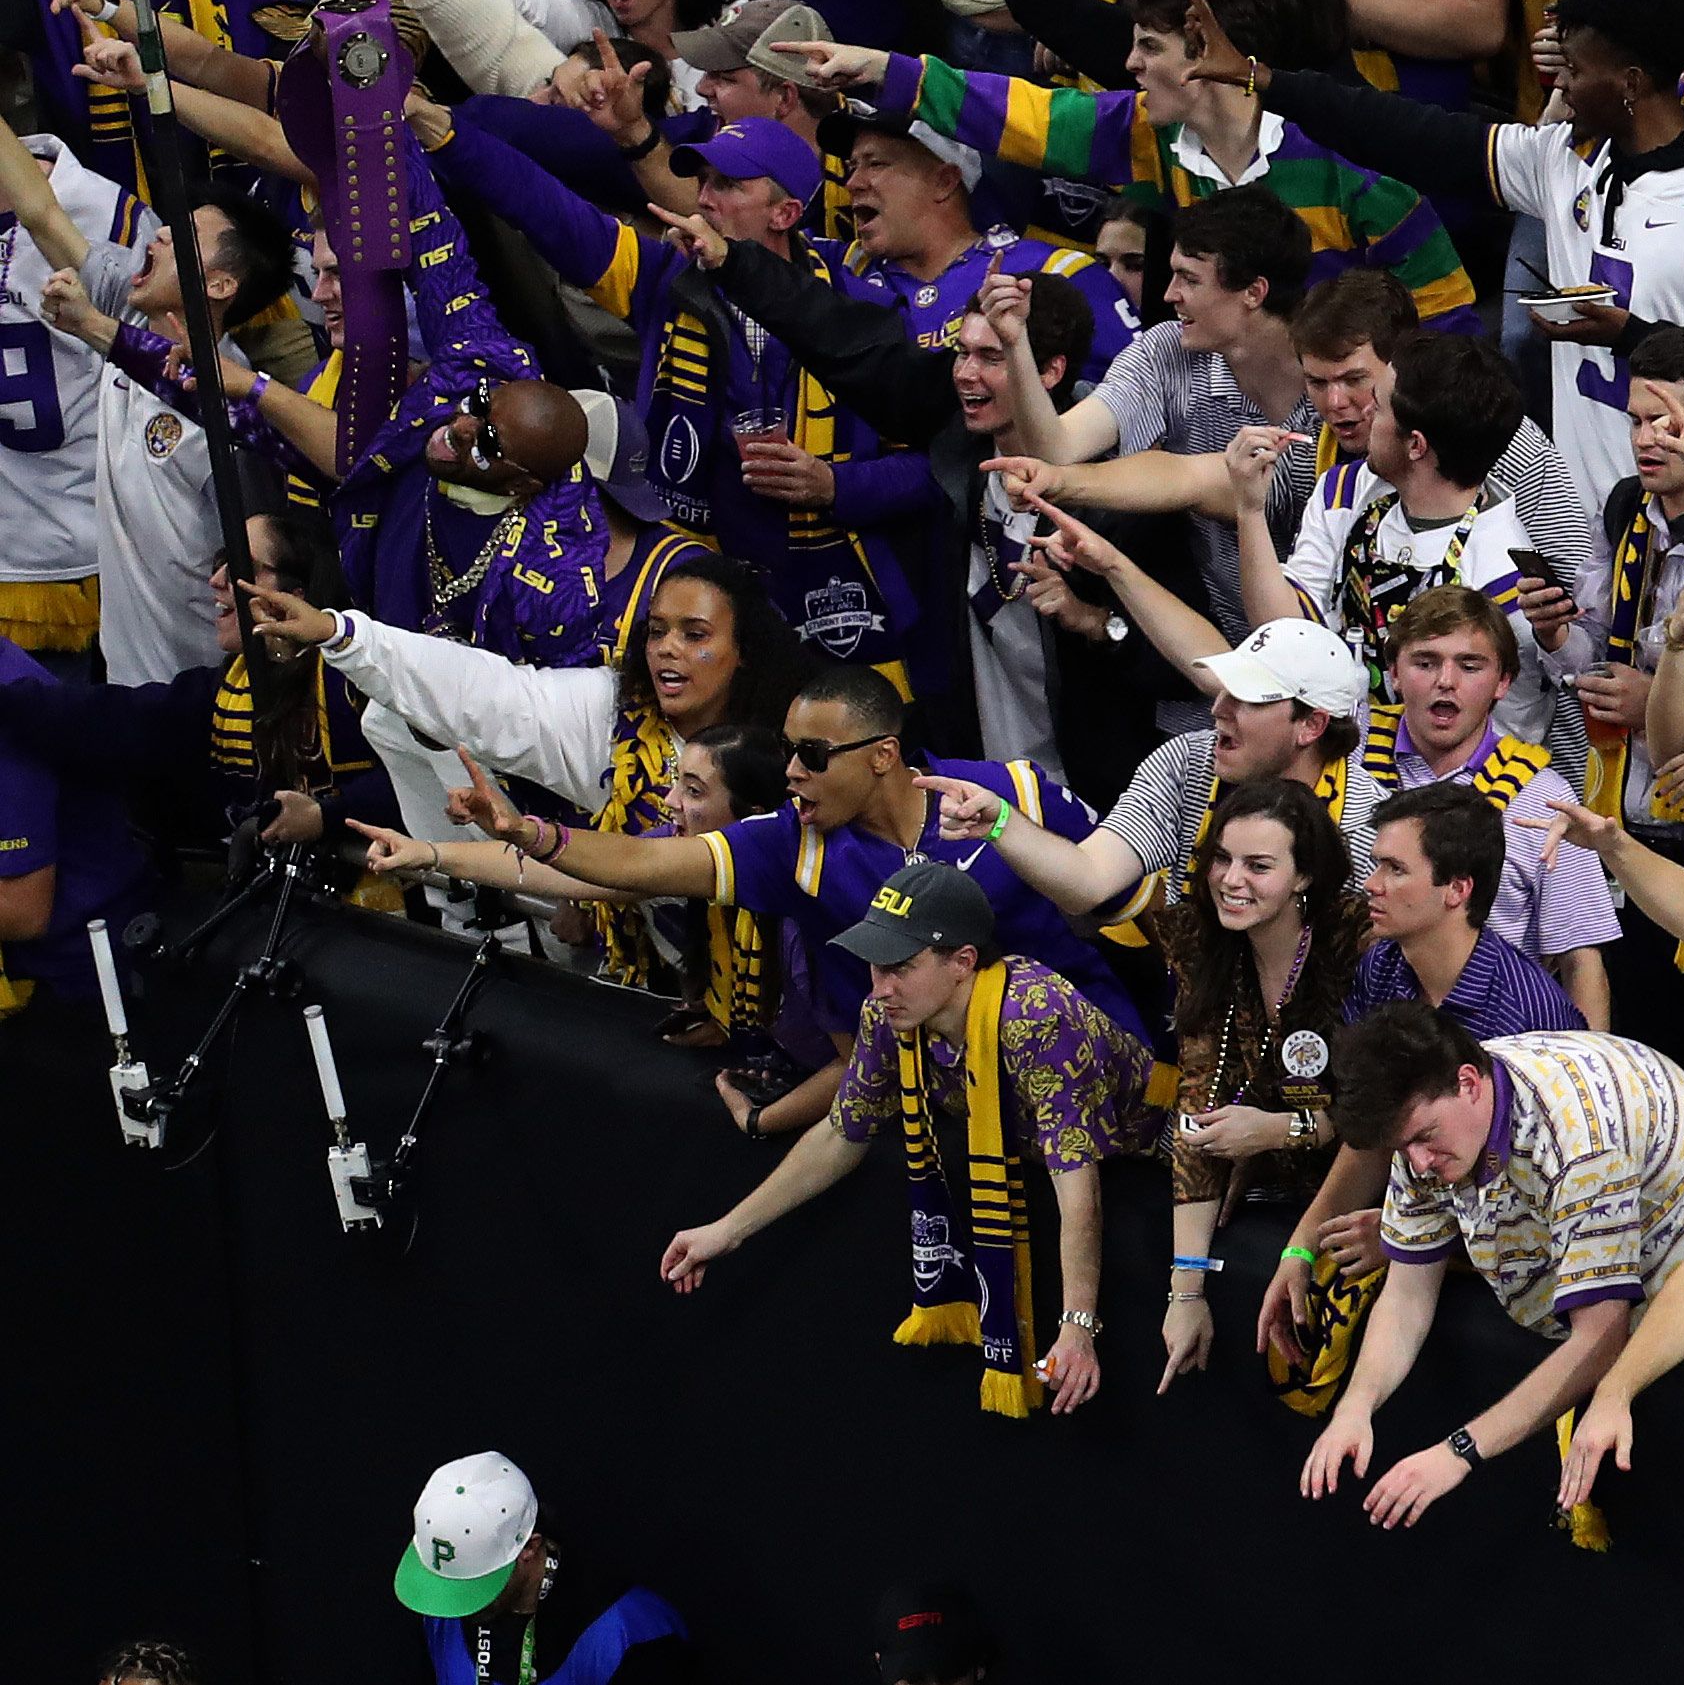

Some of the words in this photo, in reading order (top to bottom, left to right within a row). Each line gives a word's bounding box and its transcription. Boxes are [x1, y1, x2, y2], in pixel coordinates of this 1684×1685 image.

[0, 319, 67, 451] 9
[666, 499, 712, 525] YOFF
[513, 563, 554, 594] LSU
[871, 887, 912, 918] SU
[1285, 1032, 1328, 1051] KAPPA
[1286, 1060, 1328, 1076] DELTA
[432, 1537, 455, 1571] P
[896, 1609, 945, 1633] ESPN
